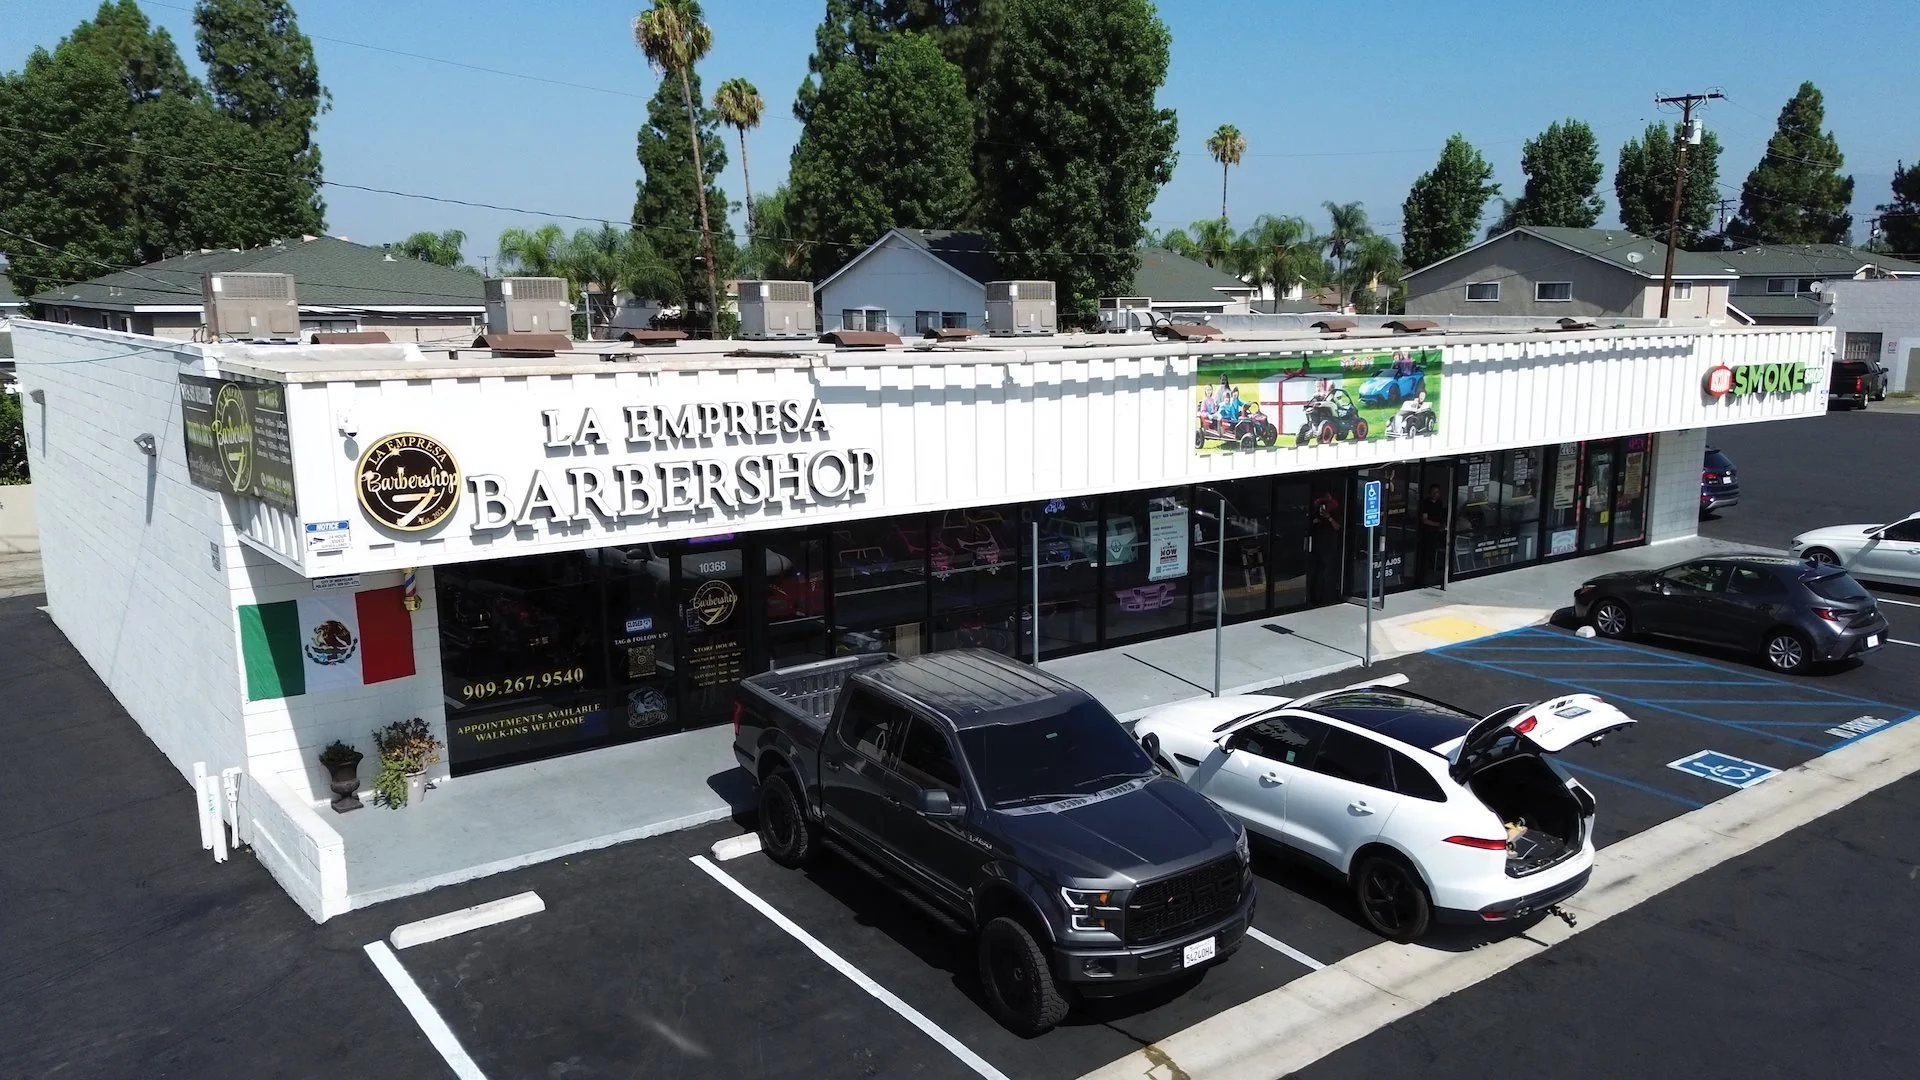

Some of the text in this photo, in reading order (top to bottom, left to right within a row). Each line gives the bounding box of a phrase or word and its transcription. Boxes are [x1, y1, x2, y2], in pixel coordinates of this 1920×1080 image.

[1734, 362, 1805, 395] SMOKE
[541, 398, 834, 450] LA EMPRESA
[368, 437, 447, 465] LA EMPRESA
[361, 466, 458, 494] Barbershop
[467, 447, 880, 531] BARBERSHOP
[316, 522, 339, 531] NOTICE
[698, 561, 726, 573] 10368
[1160, 549, 1177, 557] NOW
[1376, 568, 1393, 579] JBS
[632, 634, 657, 643] FOLLOW
[463, 667, 584, 700] 909.267.9540
[457, 703, 601, 735] APPOINTMENTS AVAILABLE
[475, 715, 585, 742] WALK-INS WELCOME
